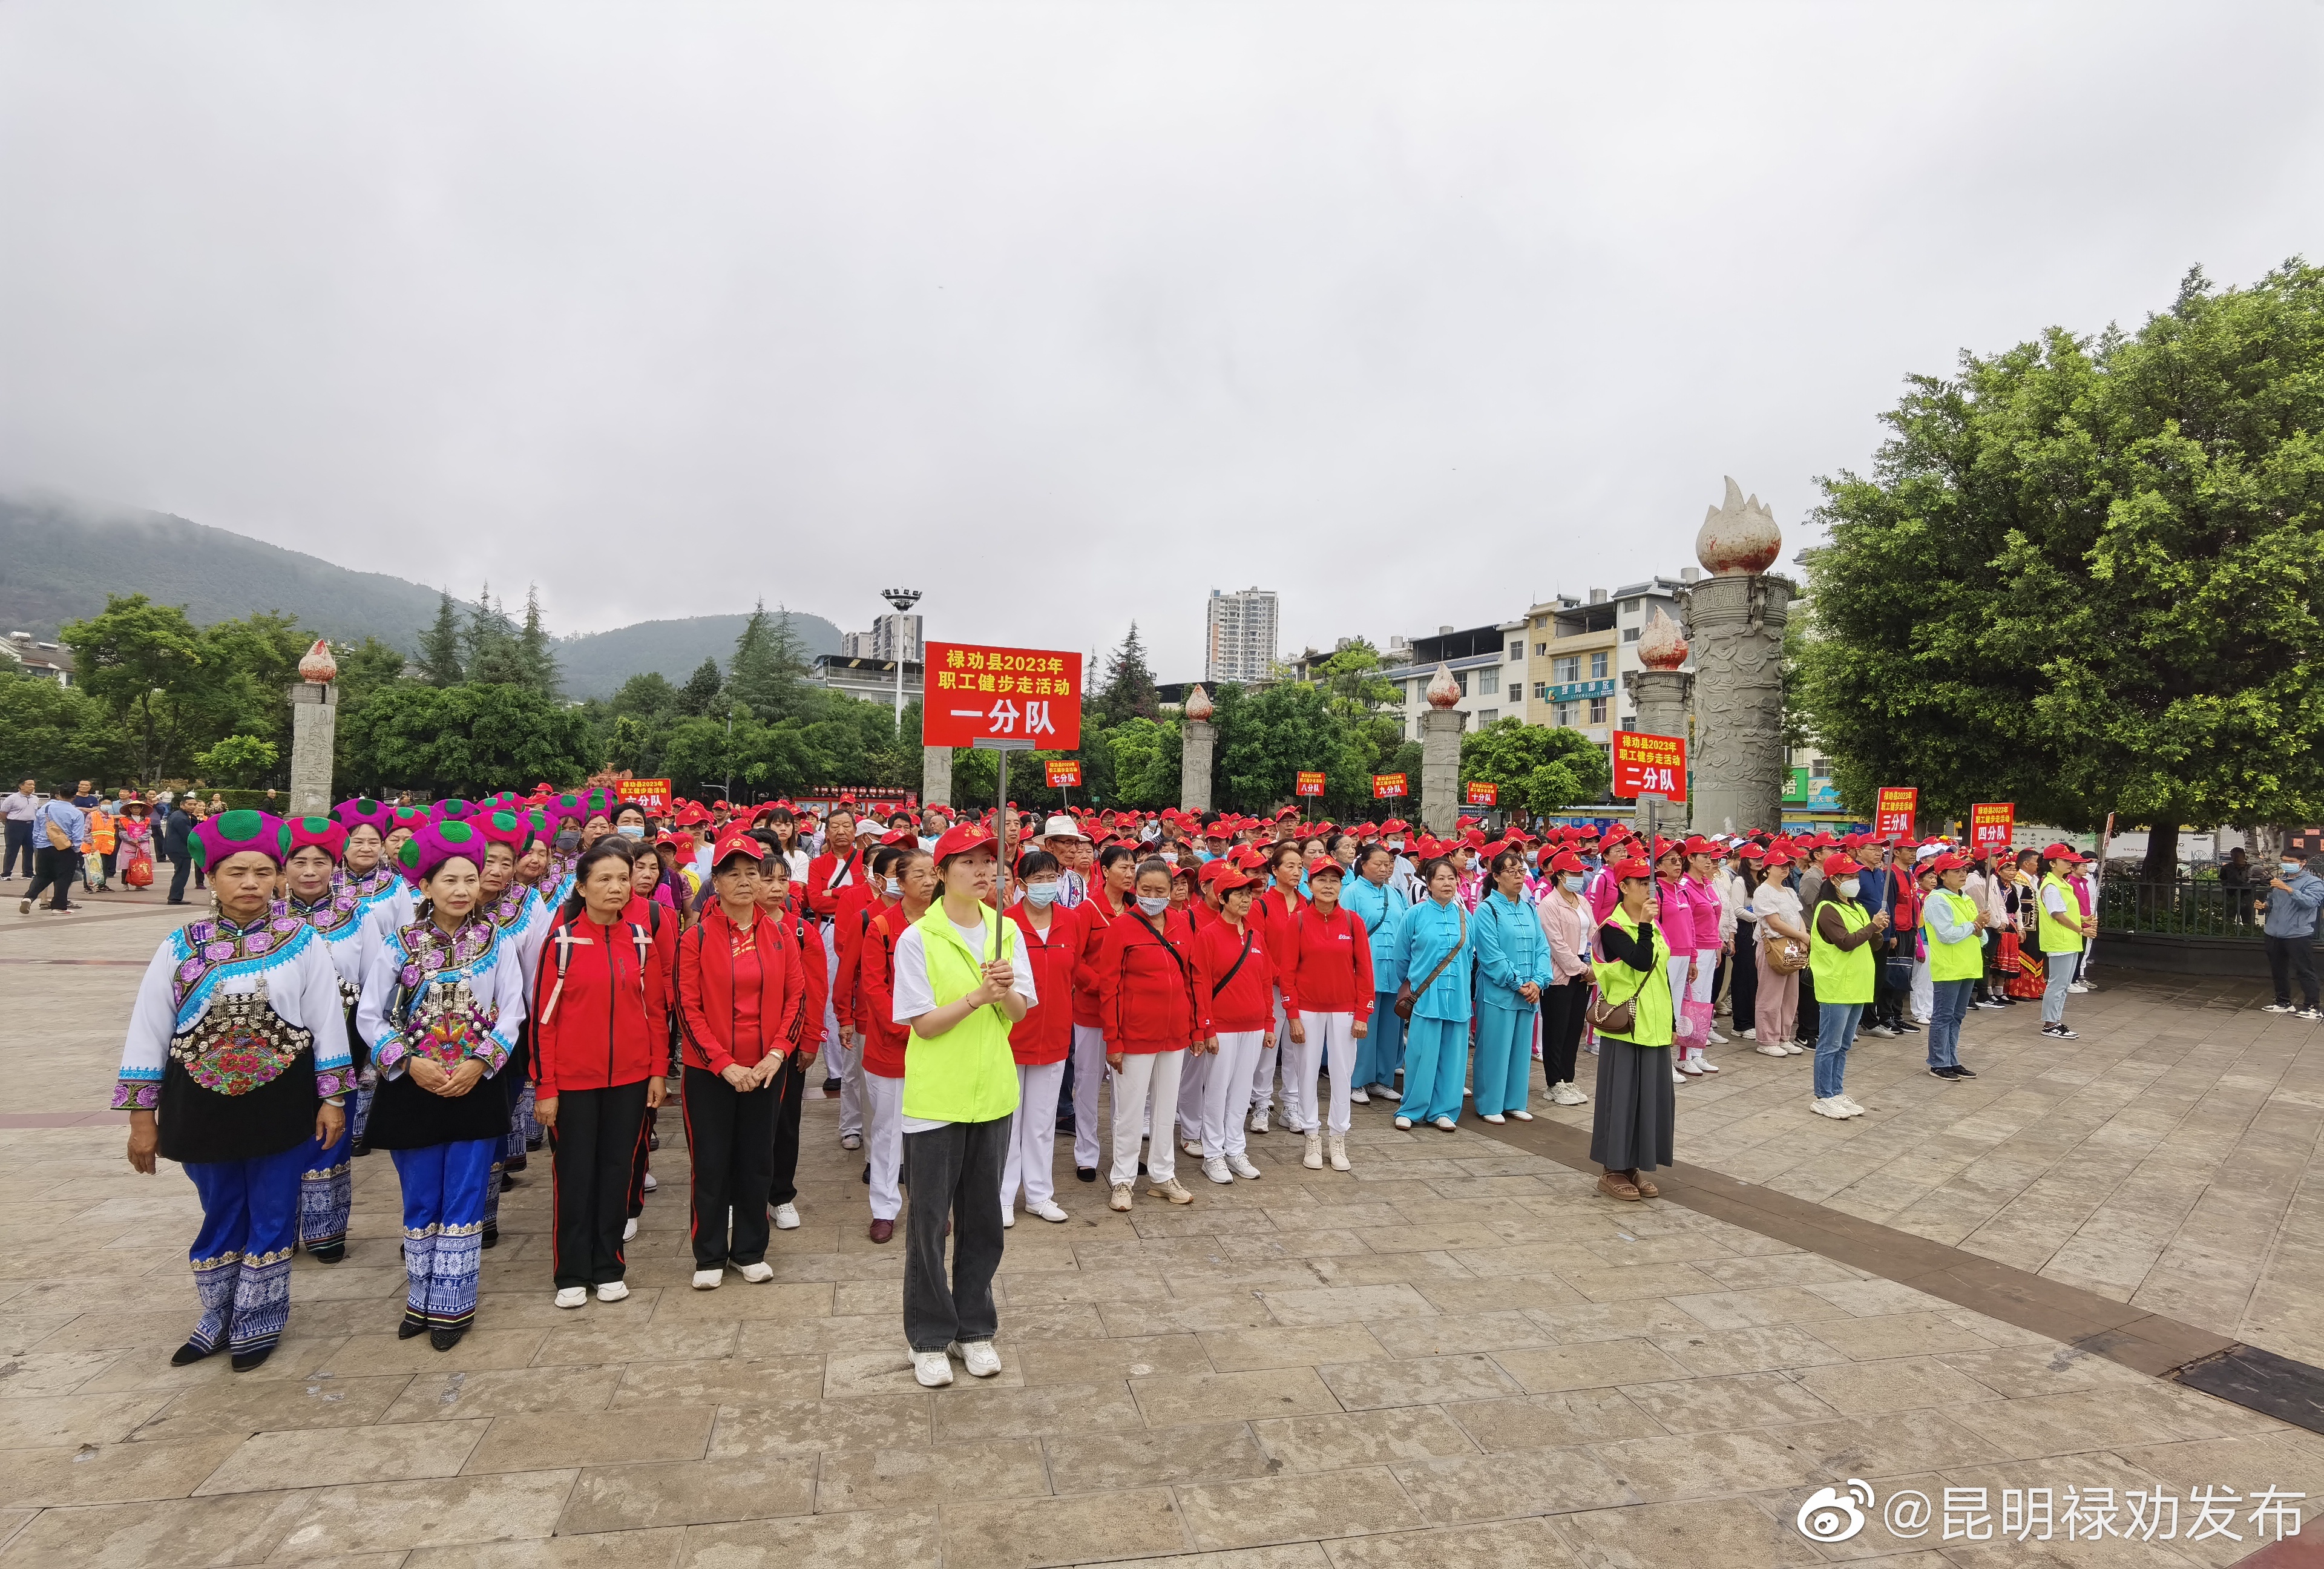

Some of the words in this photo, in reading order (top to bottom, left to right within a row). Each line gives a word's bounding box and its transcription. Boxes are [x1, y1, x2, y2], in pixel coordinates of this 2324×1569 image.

[947, 649, 1063, 675] 禄劝县2023年
[938, 671, 1070, 696] 职工健步走活动
[950, 699, 1055, 735] 一分队
[1622, 735, 1677, 753] 禄劝县2023年
[1619, 748, 1681, 766] 职工健步走活动
[1052, 773, 1076, 783] 七分队
[1626, 767, 1675, 792] 二分队
[1301, 783, 1319, 792] 八分队
[1379, 784, 1402, 795] 九分队
[1471, 792, 1491, 802] 十分队
[1882, 814, 1908, 831] 三分队
[1978, 824, 2006, 840] 四分队
